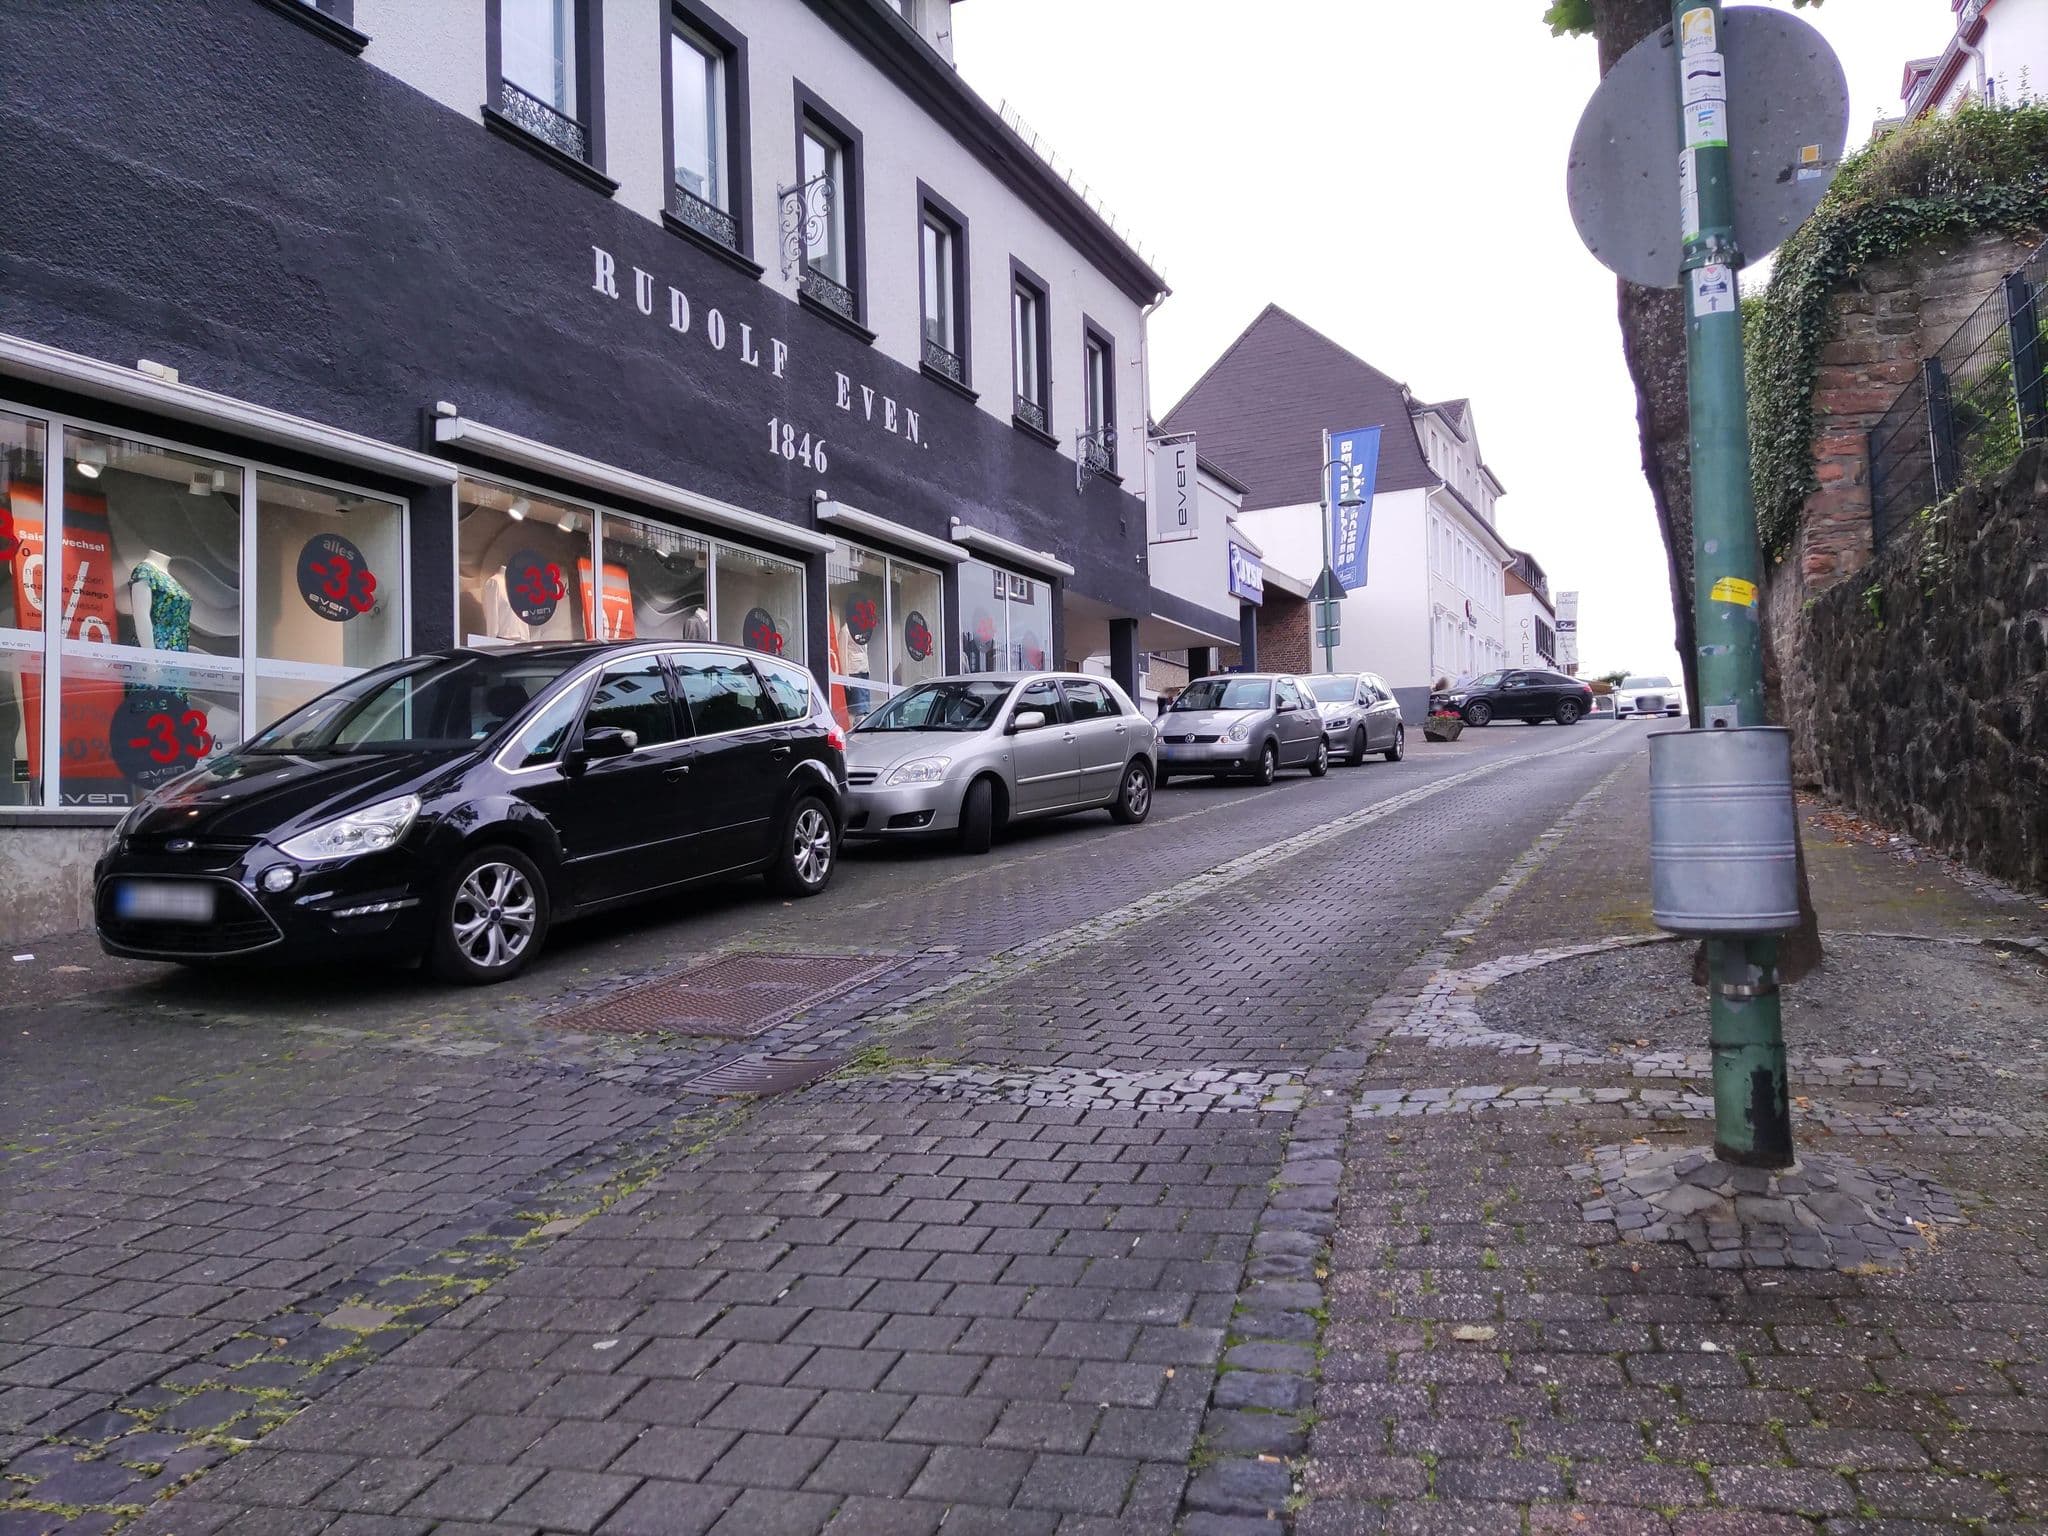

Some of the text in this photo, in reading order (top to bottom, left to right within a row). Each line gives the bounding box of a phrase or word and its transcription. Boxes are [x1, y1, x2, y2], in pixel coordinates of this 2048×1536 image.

[592, 245, 788, 379] RUDOLF
[767, 417, 828, 473] 1846
[1176, 450, 1187, 526] even
[323, 540, 355, 560] alles
[309, 593, 349, 616] even
